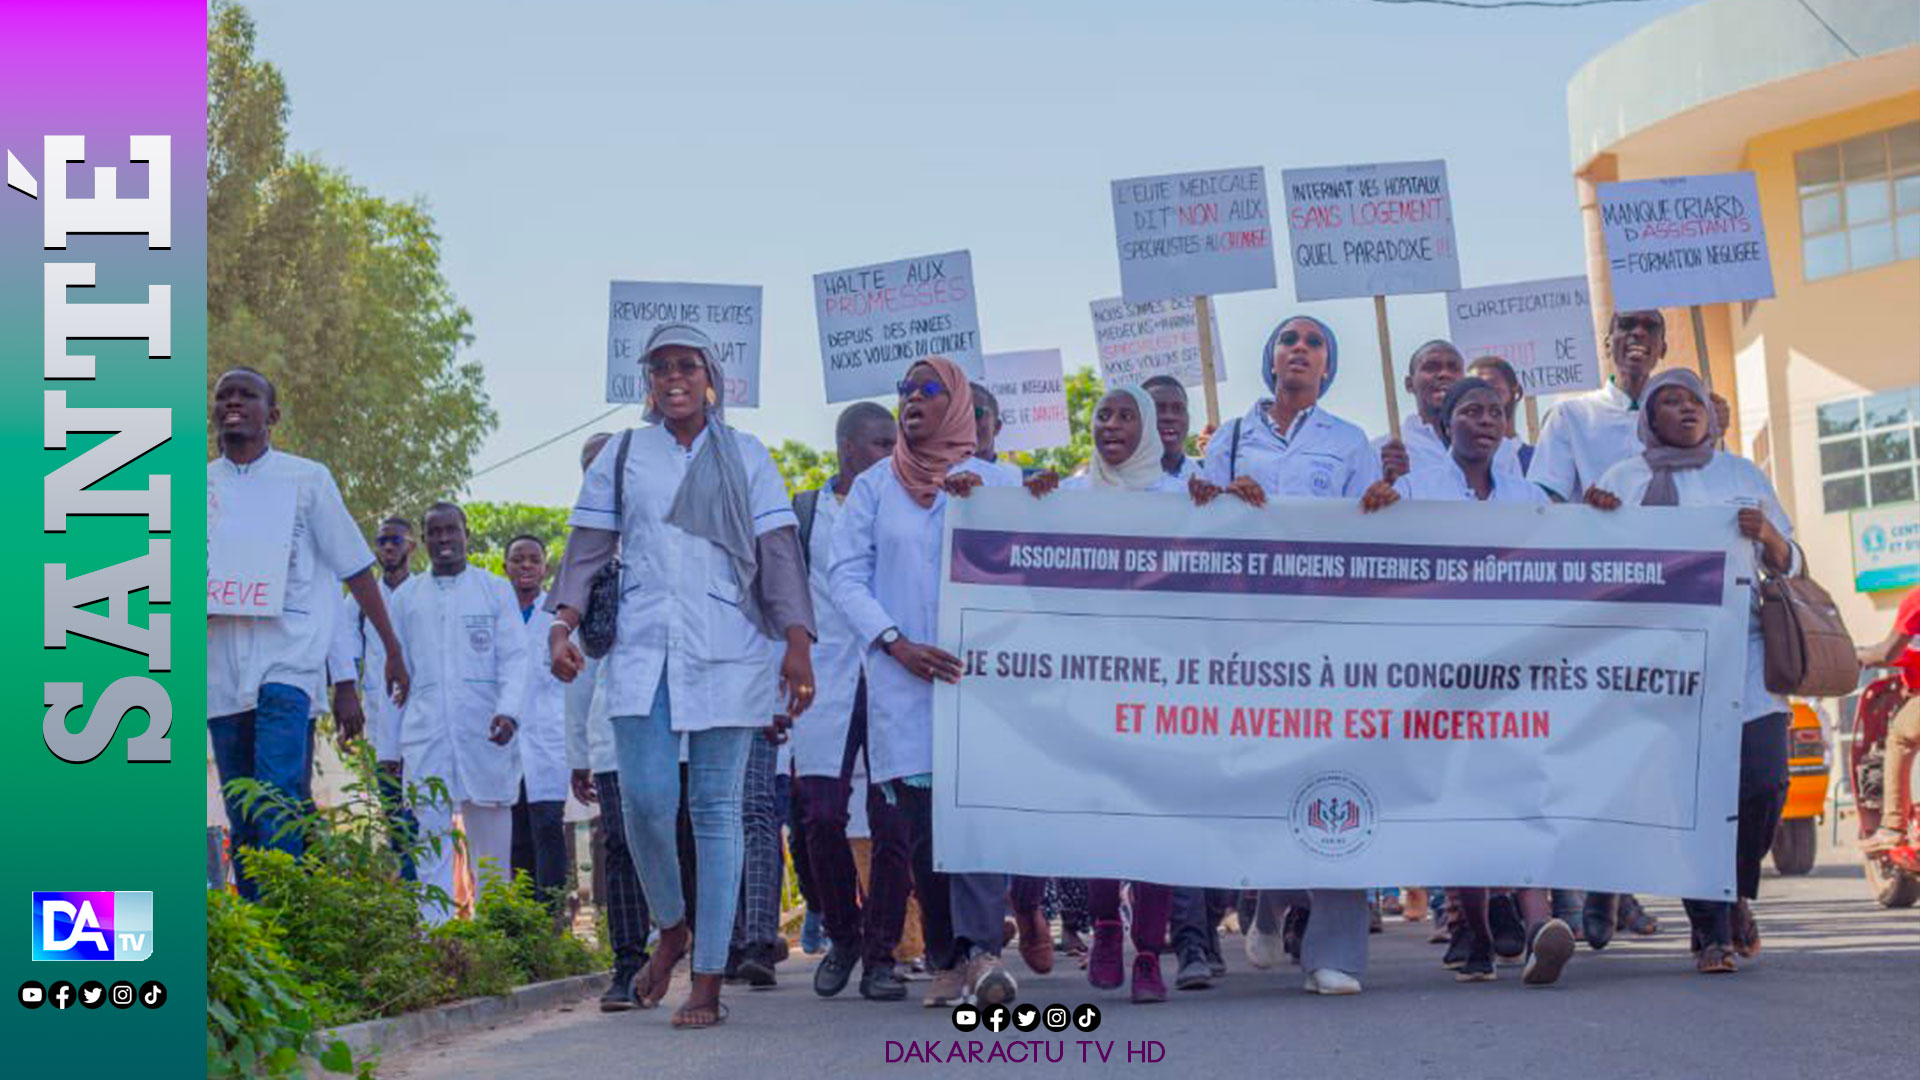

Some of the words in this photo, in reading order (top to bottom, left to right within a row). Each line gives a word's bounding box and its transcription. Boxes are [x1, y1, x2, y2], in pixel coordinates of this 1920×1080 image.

[1179, 172, 1259, 197] MEDICALE
[1292, 180, 1354, 202] INTERNAT
[1134, 206, 1172, 230] DIT
[1178, 202, 1219, 227] NON
[1229, 198, 1265, 220] AUX
[1289, 203, 1343, 230] SANS
[1602, 199, 1672, 226] MANQUE
[1674, 195, 1745, 220] CRIARD
[1642, 217, 1752, 239] ASSISTANTS
[1296, 242, 1338, 268] QUEL
[1343, 237, 1433, 264] PARADOXE
[824, 269, 886, 295] HALTE
[906, 260, 946, 283] AUX
[825, 275, 970, 317] PROMESSES
[1457, 292, 1572, 320] CLARIFICATION
[613, 301, 678, 322] REVISION
[706, 305, 754, 325] TEXTES
[614, 339, 632, 358] DE
[827, 327, 874, 348] DEPUIS
[883, 322, 907, 340] DES
[1555, 337, 1577, 360] DE
[830, 350, 862, 370] NOUS
[864, 341, 914, 364] VOULONS
[1010, 544, 1119, 572] ASSOCIATION
[1124, 548, 1157, 572] DES
[1163, 549, 1242, 575] INTERNES
[1247, 552, 1268, 575] ET
[1272, 553, 1344, 578] ANCIENS
[1350, 556, 1430, 581] INTERNES
[1436, 559, 1468, 582] DES
[1473, 555, 1557, 584] HÔPITAUX
[1563, 562, 1586, 583] DU
[1591, 562, 1665, 586] SENEGAL
[964, 650, 988, 676] JE
[996, 652, 1052, 679] SUIS
[1061, 654, 1168, 686] INTERNE,
[1175, 658, 1200, 685] JE
[1209, 652, 1312, 688] RÉUSSIS
[1319, 655, 1335, 688] À
[1344, 663, 1378, 689] UN
[1387, 663, 1521, 691] CONCOURS
[1529, 658, 1588, 691] TRÈS
[1596, 666, 1701, 697] SELECTIF
[1115, 703, 1146, 735] ET
[1155, 704, 1219, 736] MON
[1230, 707, 1333, 738] AVENIR
[1344, 709, 1393, 740] EST
[1403, 709, 1550, 741] INCERTAIN
